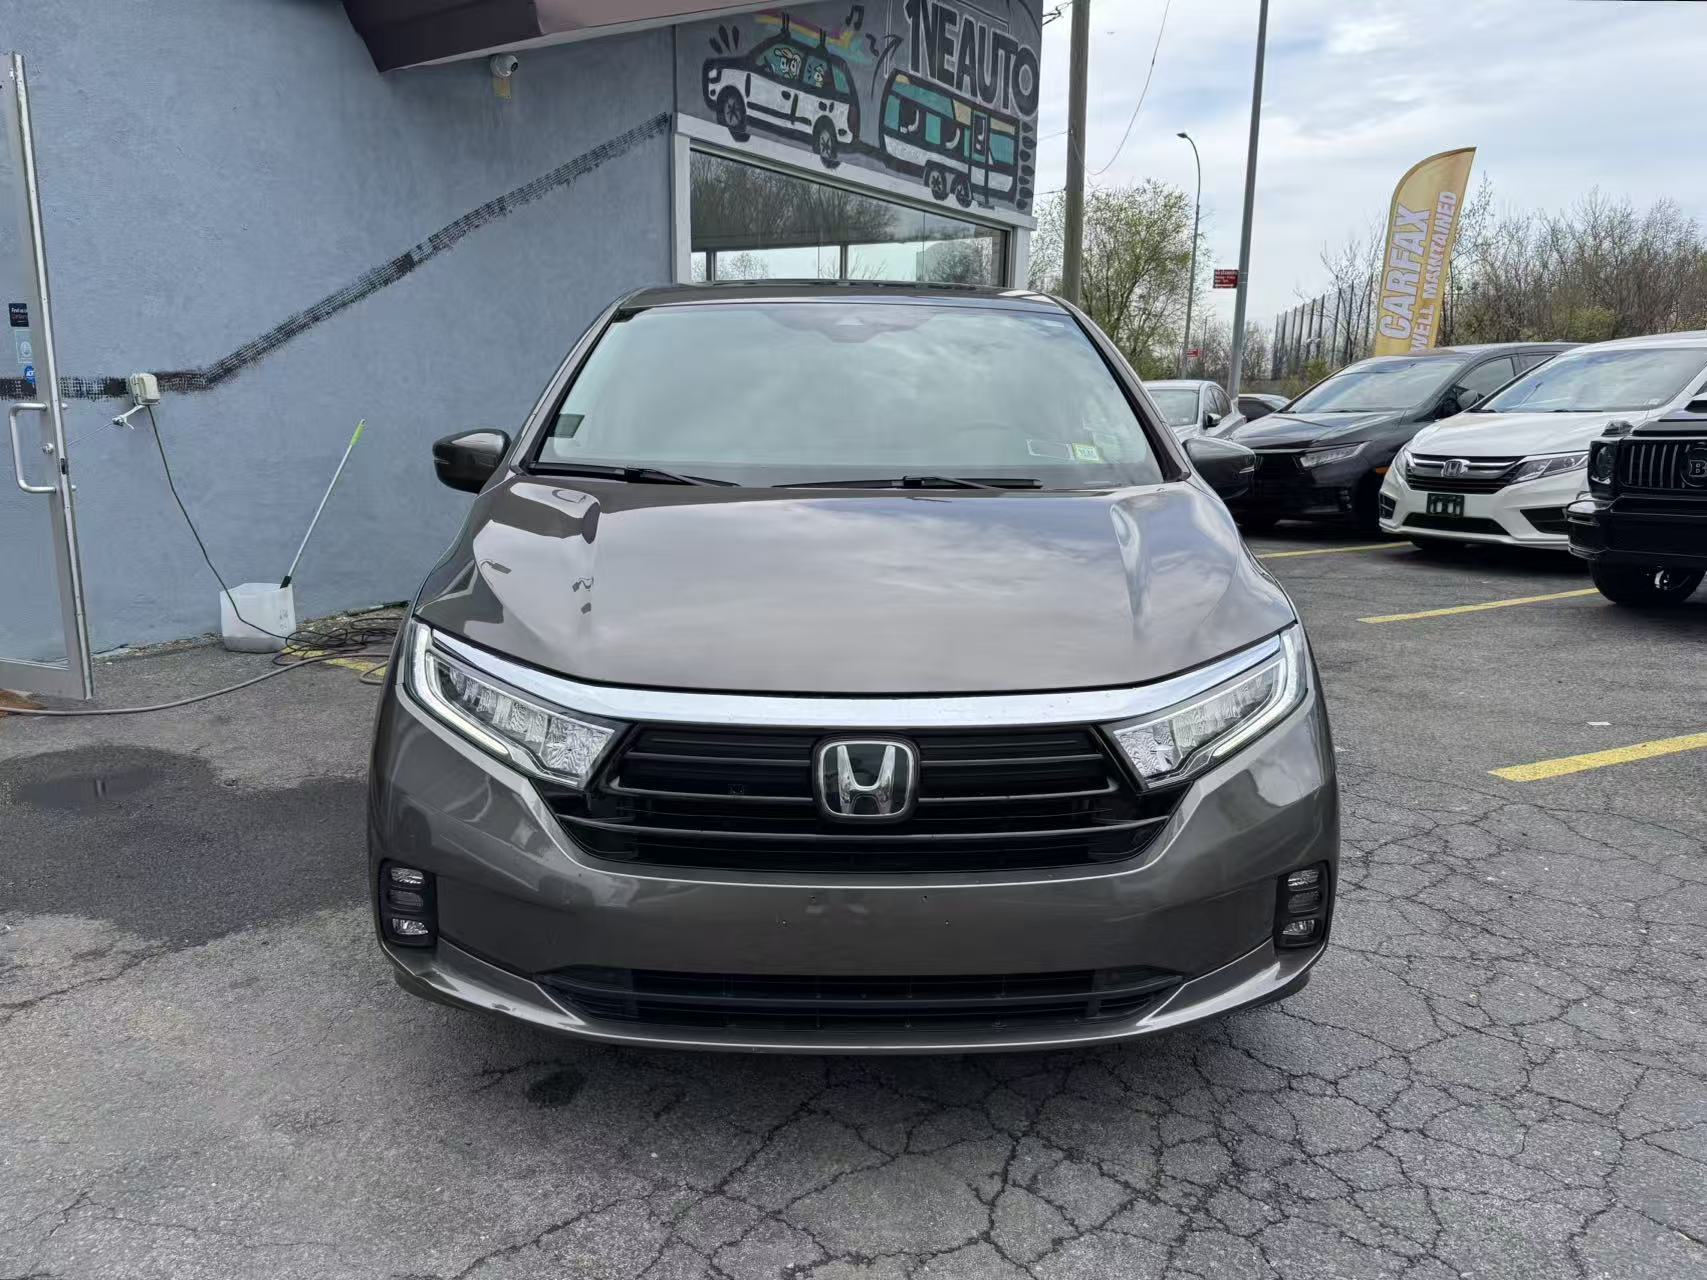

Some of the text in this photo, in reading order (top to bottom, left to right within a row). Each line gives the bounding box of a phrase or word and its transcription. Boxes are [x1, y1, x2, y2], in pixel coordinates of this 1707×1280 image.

[1379, 203, 1431, 340] CARFAX
[1411, 191, 1457, 351] WELL MAINTAINED
